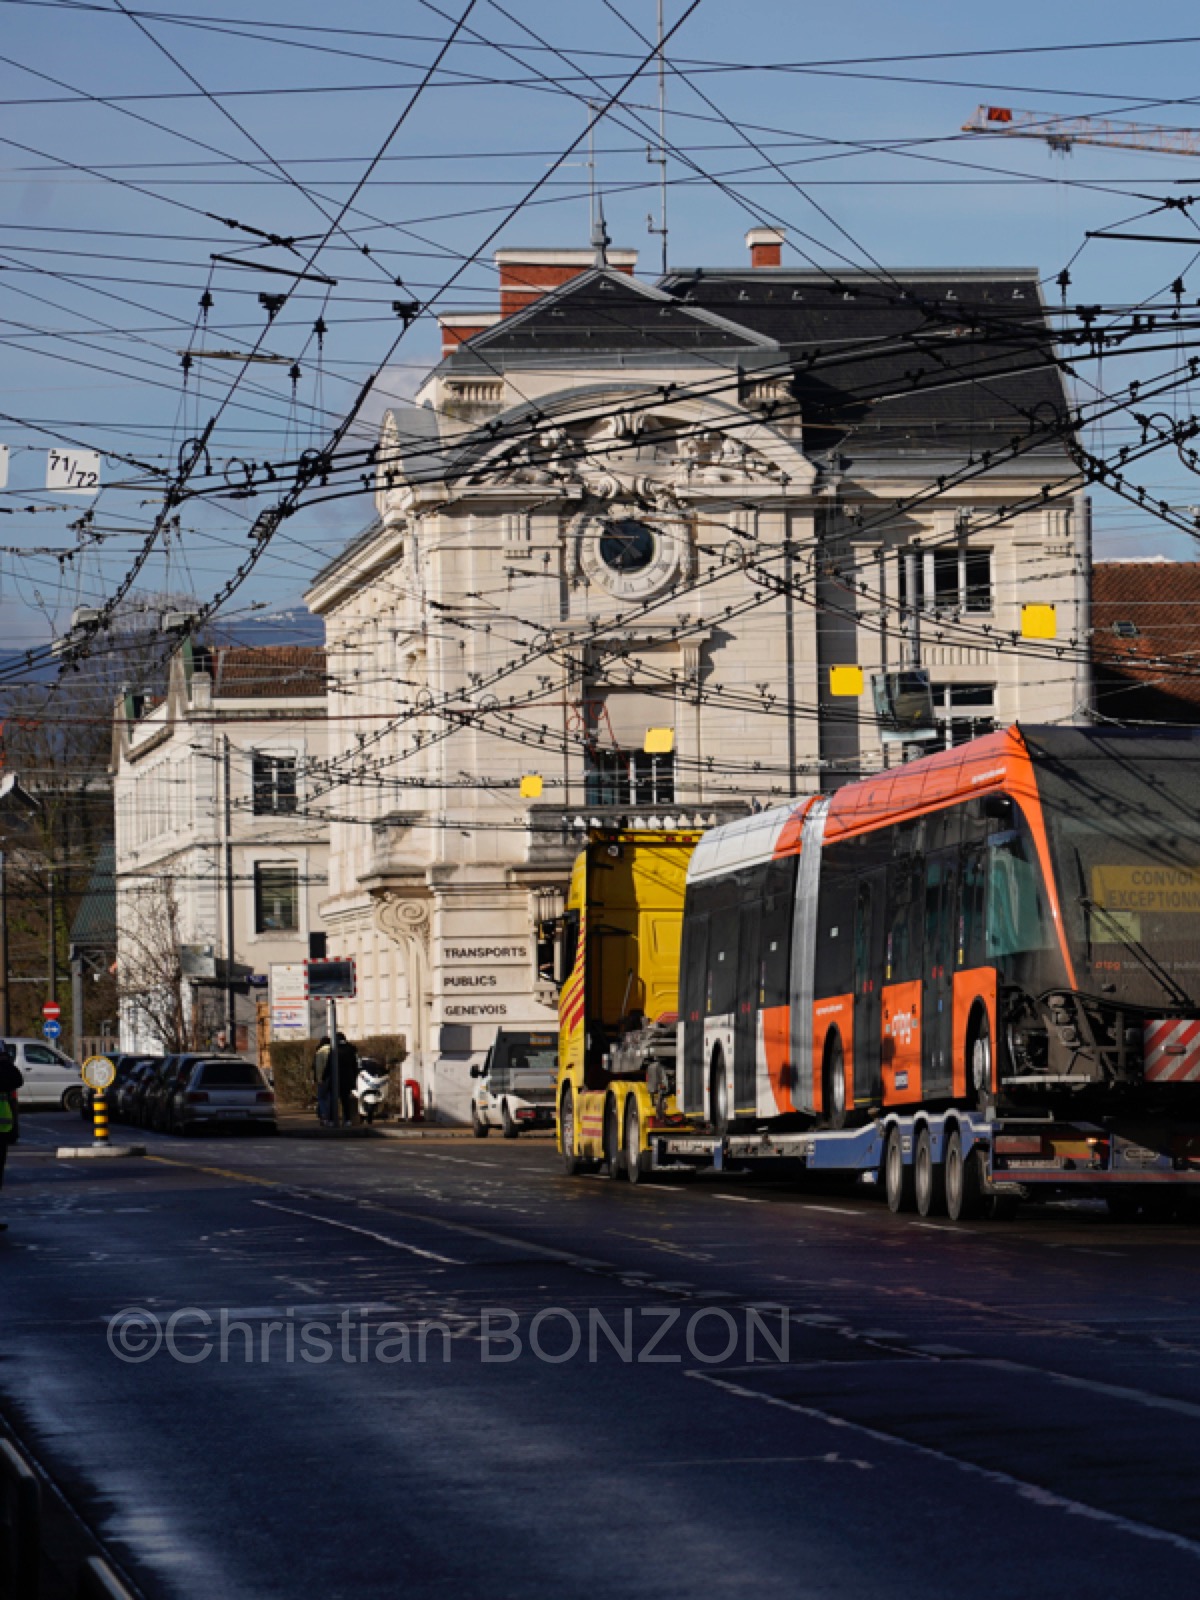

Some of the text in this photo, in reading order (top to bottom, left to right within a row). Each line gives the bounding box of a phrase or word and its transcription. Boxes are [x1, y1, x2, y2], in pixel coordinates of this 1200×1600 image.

[49, 455, 98, 489] 71/72
[1131, 870, 1194, 886] CONVOI
[443, 946, 527, 958] TRANSPORTS
[443, 975, 497, 987] PUBLICS
[445, 1004, 508, 1016] GENEVOIS
